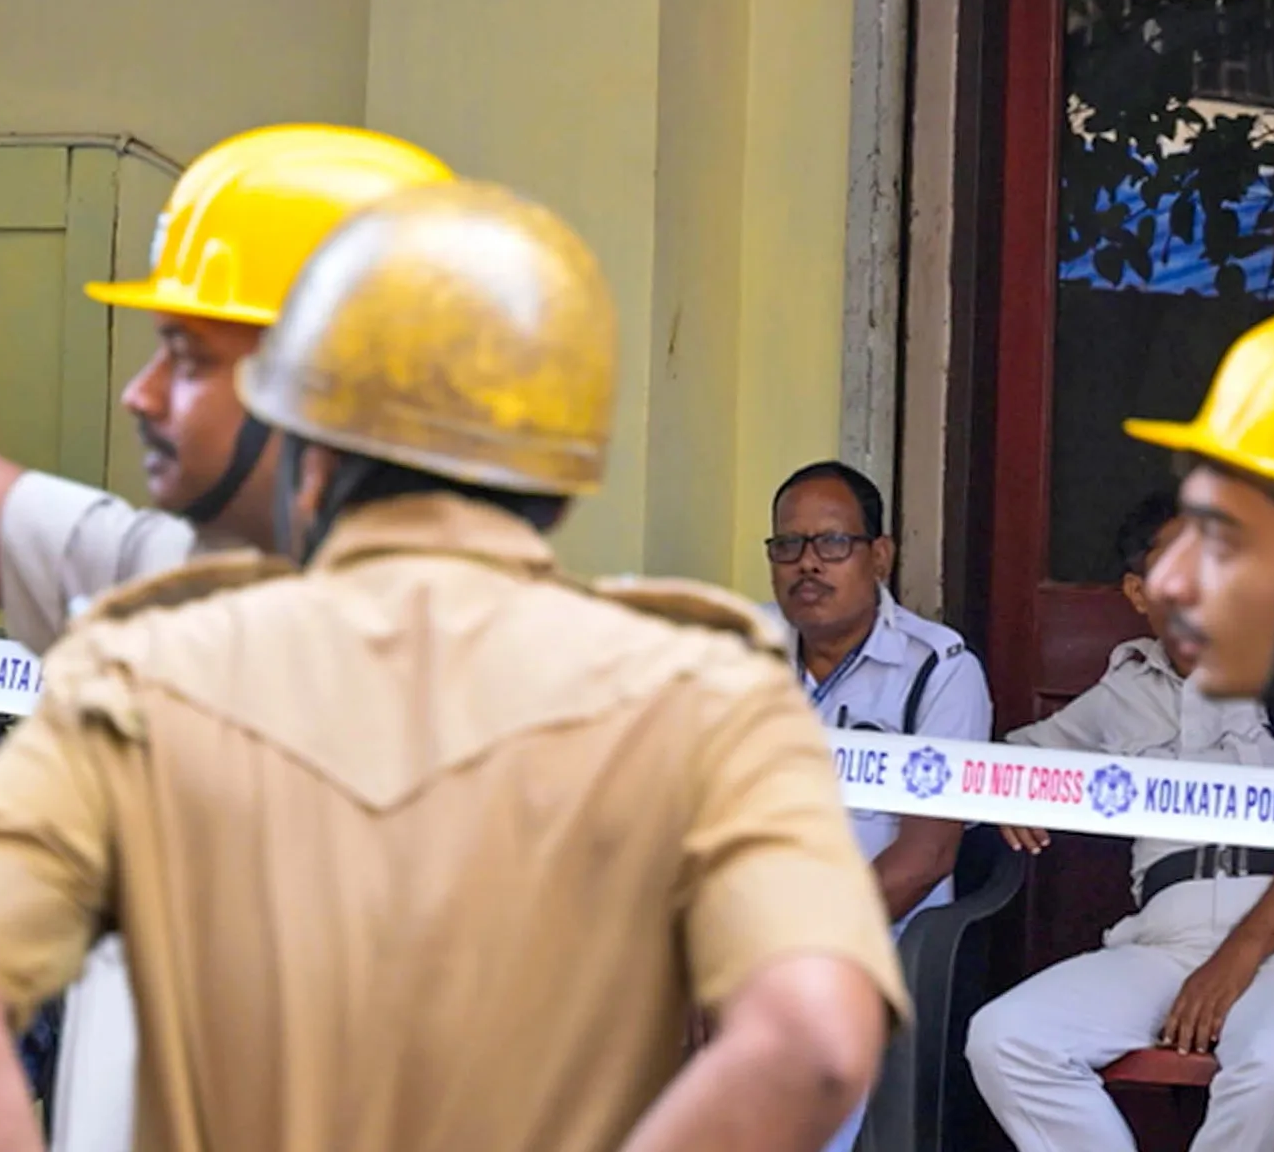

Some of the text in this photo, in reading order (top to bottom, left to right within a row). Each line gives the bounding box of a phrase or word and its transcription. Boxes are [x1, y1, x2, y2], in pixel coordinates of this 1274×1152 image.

[834, 747, 889, 785] OLICE
[961, 759, 987, 794] DO
[989, 762, 1026, 798] NOT
[1027, 765, 1085, 804] CROSS
[1143, 777, 1238, 819] KOLKATA
